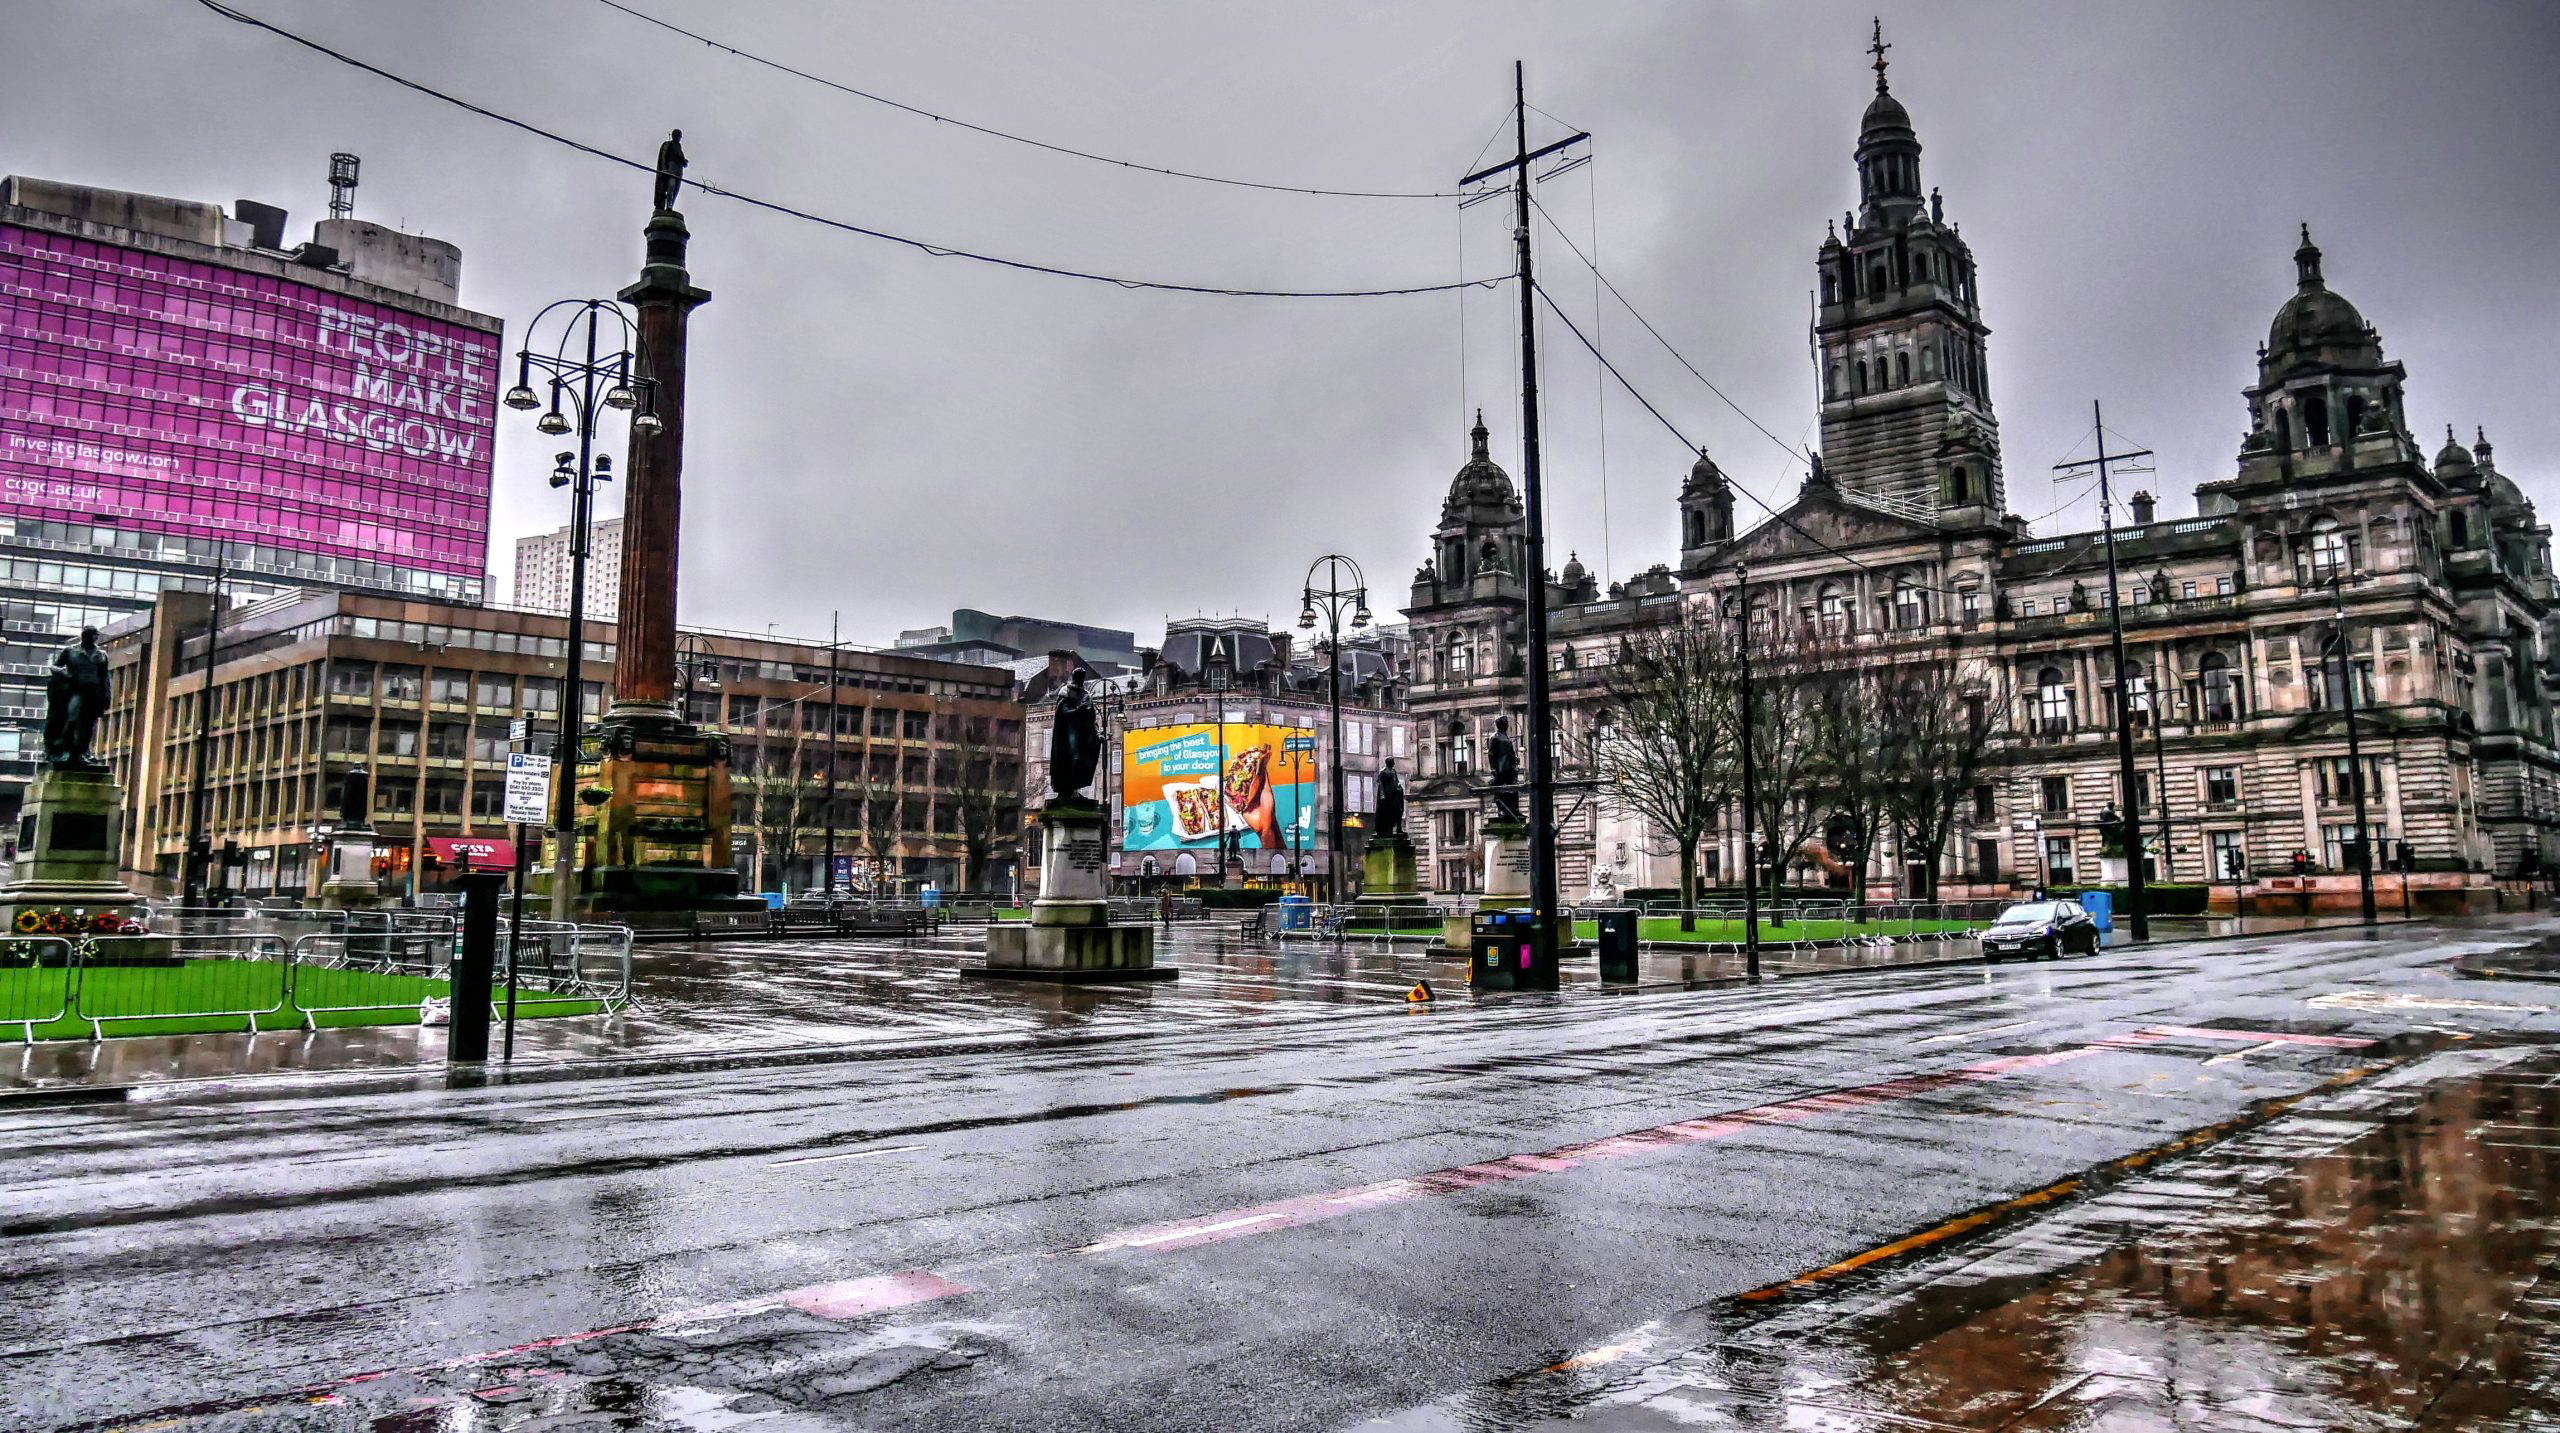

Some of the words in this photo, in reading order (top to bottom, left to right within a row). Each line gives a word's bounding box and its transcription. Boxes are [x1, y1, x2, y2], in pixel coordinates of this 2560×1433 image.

[317, 305, 485, 385] PEOPLE
[352, 363, 482, 425] MAKE
[231, 383, 479, 466] GLASGOW
[9, 434, 180, 470] investglasgow.com
[1139, 746, 1169, 760] bringing
[1170, 742, 1182, 751] the
[1182, 737, 1205, 748] best
[1174, 752, 1182, 760] of
[514, 756, 522, 767] P
[1163, 764, 1171, 772] to
[1172, 763, 1190, 773] your
[1191, 760, 1215, 769] door
[450, 843, 495, 853] COSTA
